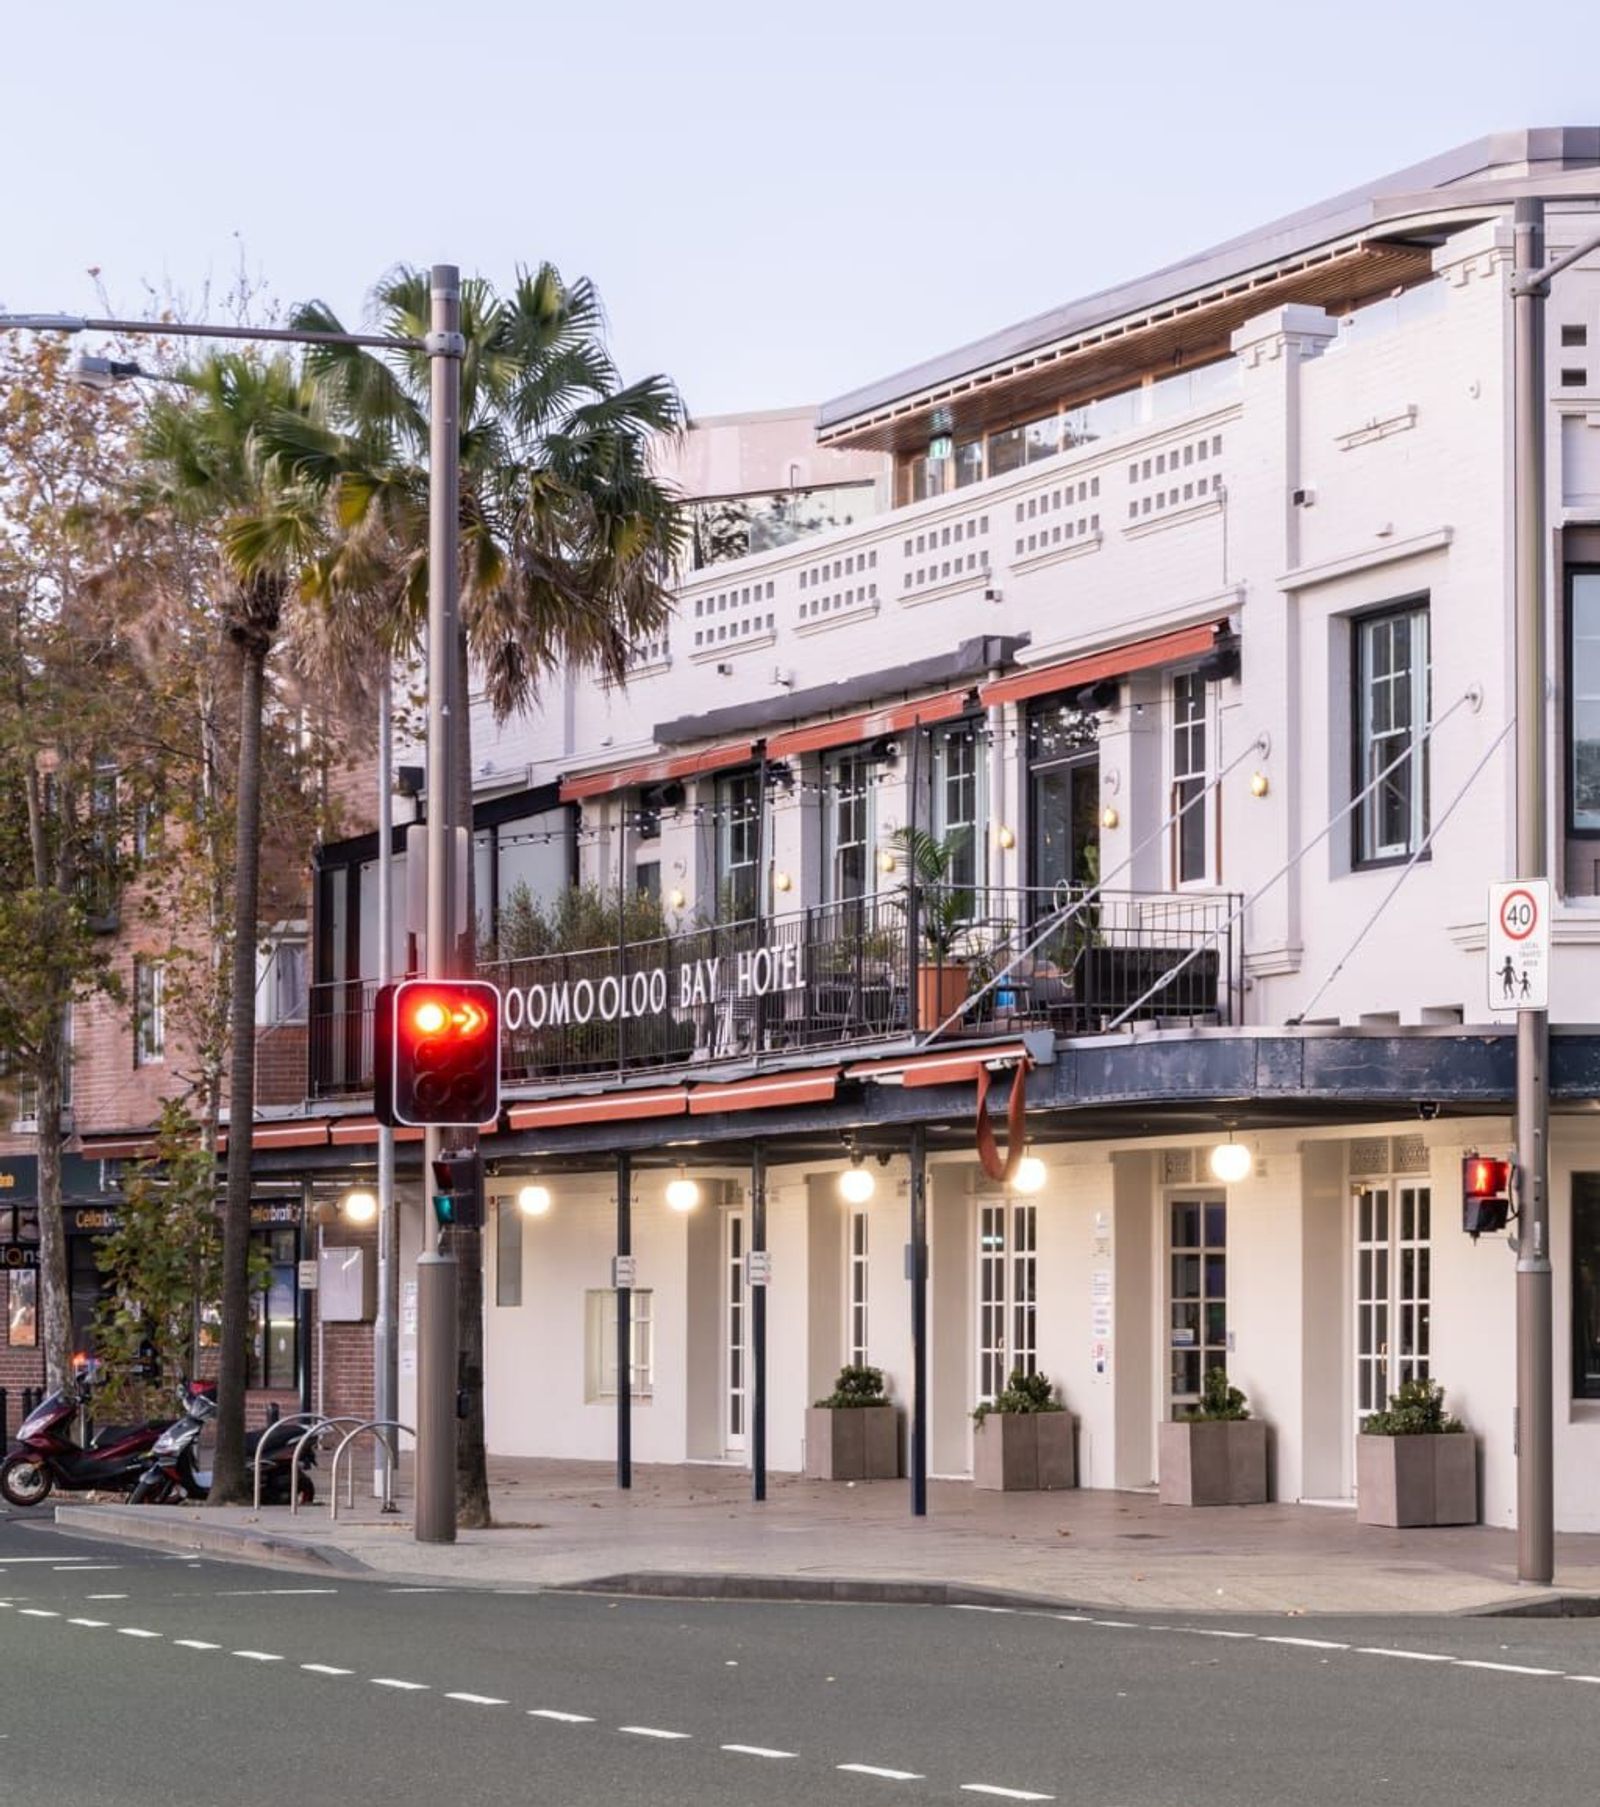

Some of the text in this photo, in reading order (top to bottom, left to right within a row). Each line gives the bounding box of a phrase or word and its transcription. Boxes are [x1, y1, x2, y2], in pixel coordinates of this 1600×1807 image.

[1507, 904, 1531, 926] 40
[505, 942, 807, 1030] OOMOOLOO BAY HOTEL
